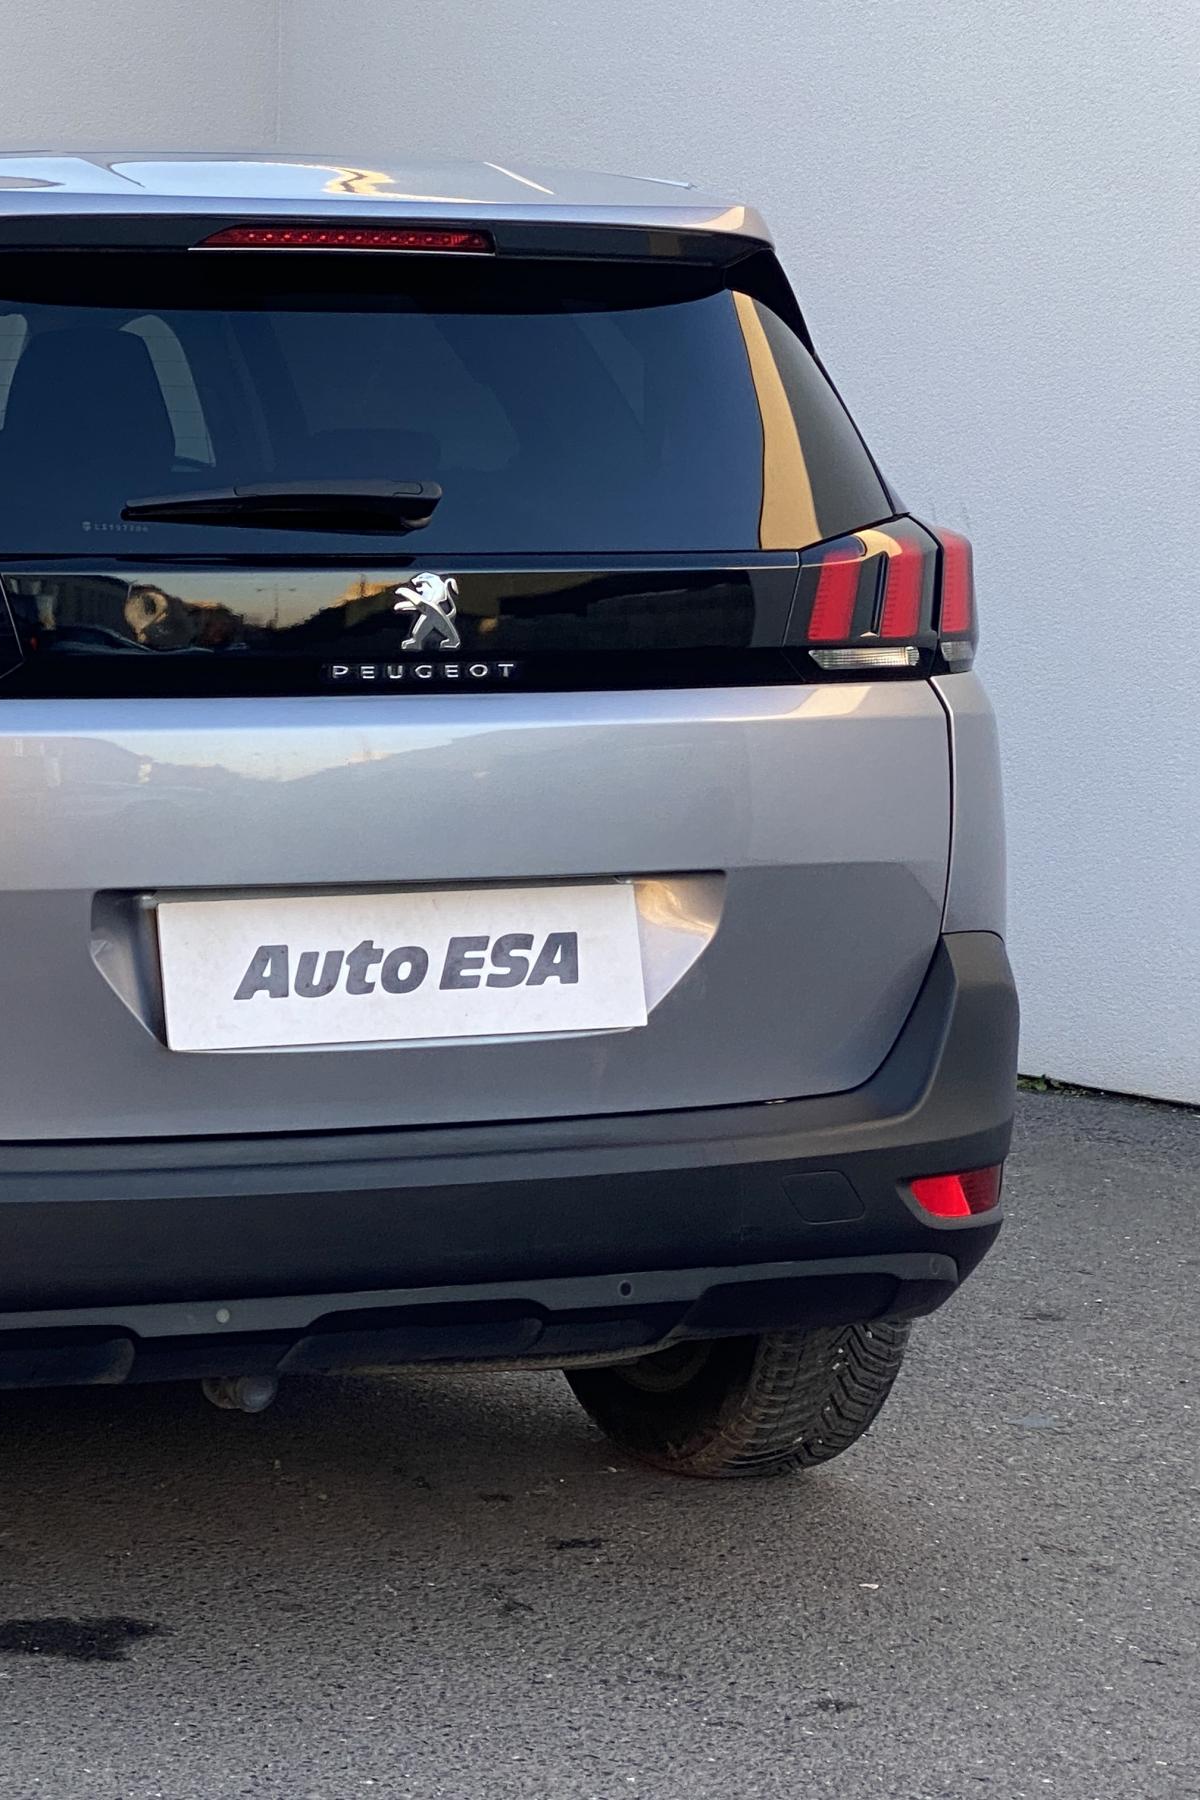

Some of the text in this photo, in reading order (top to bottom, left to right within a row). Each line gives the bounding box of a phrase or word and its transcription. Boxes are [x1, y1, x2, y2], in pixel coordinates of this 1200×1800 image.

[331, 663, 515, 679] PEUGEOT
[233, 931, 579, 1000] Auto ESA
